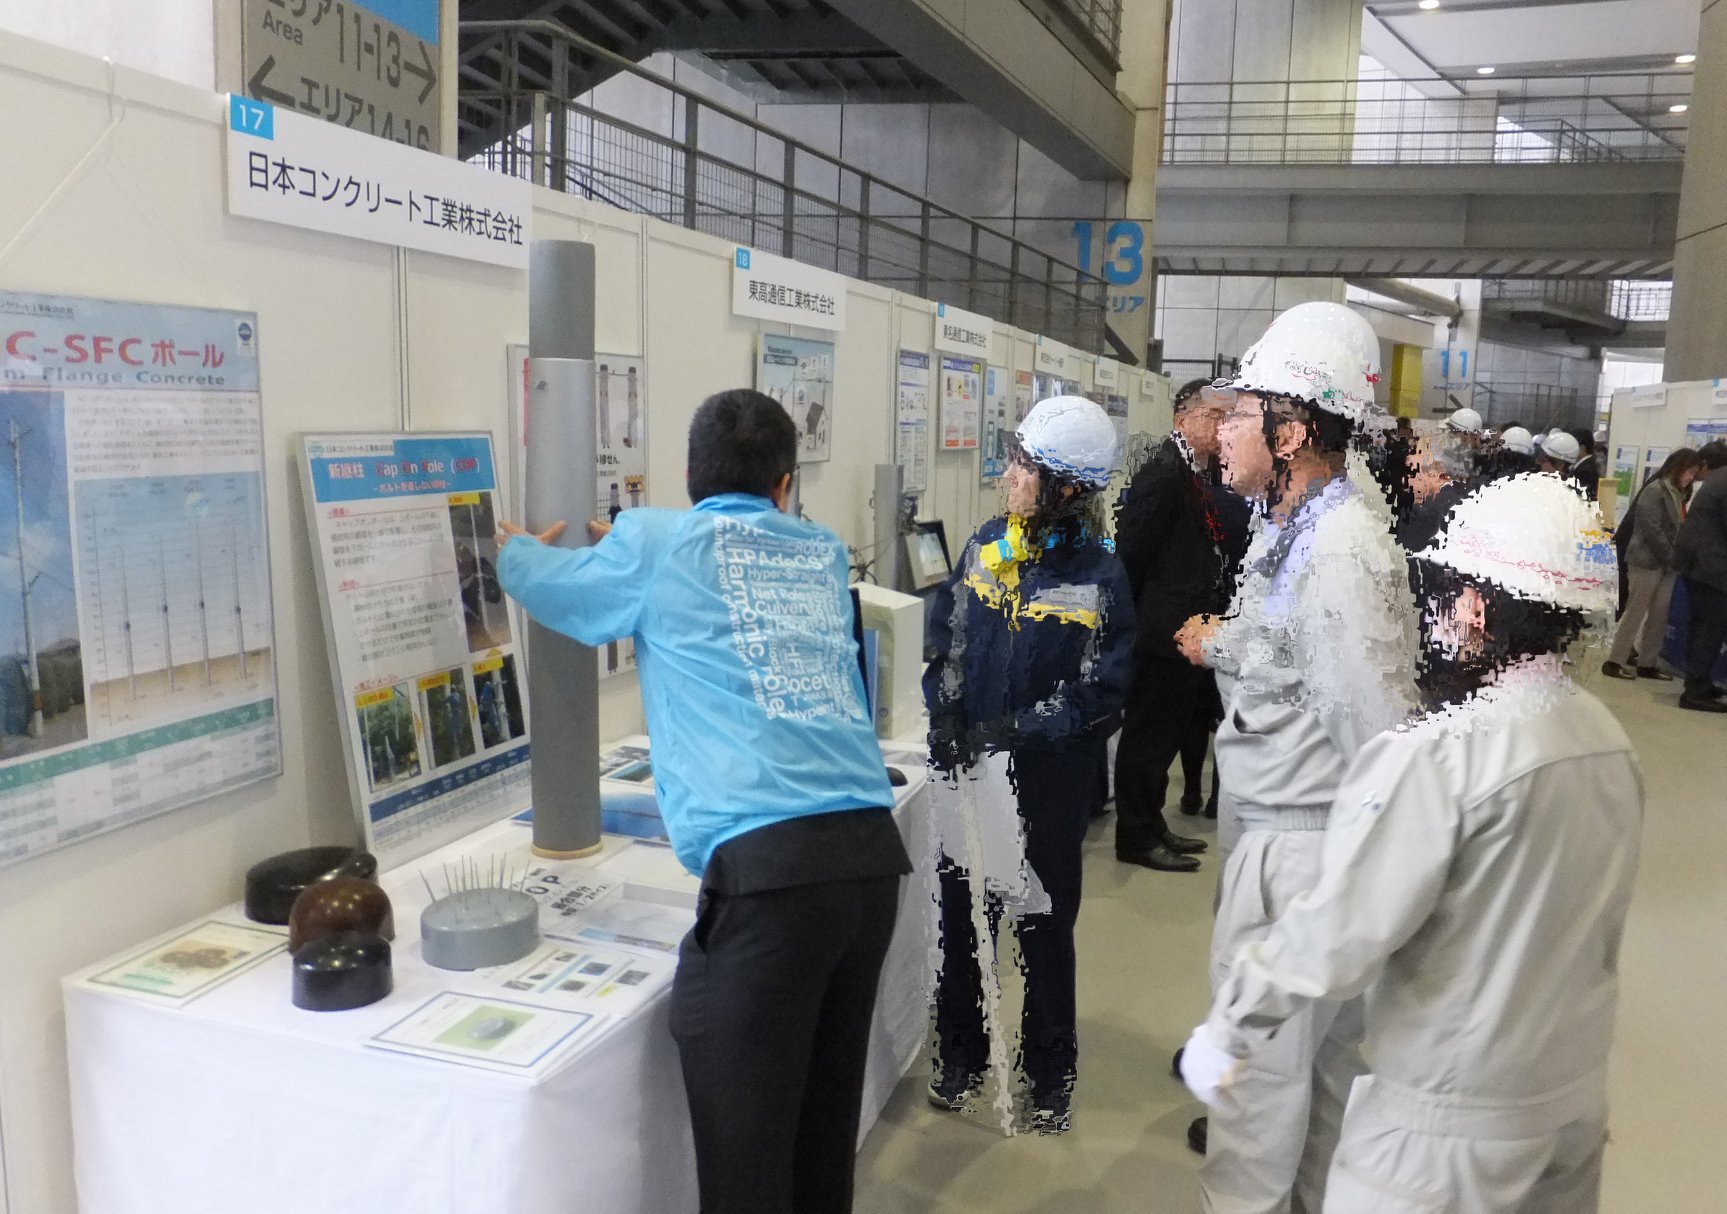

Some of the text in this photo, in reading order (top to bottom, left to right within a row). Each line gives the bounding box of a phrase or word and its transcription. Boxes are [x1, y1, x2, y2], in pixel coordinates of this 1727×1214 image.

[262, 10, 304, 46] Area
[239, 103, 265, 130] 17
[247, 150, 523, 246] 日本コンクリート工業株式会社
[1072, 220, 1144, 285] 13
[748, 279, 836, 316] 東高通信工業株式会社
[42, 367, 123, 384] Flange
[136, 370, 225, 385] Concrete
[1440, 351, 1468, 378] 11
